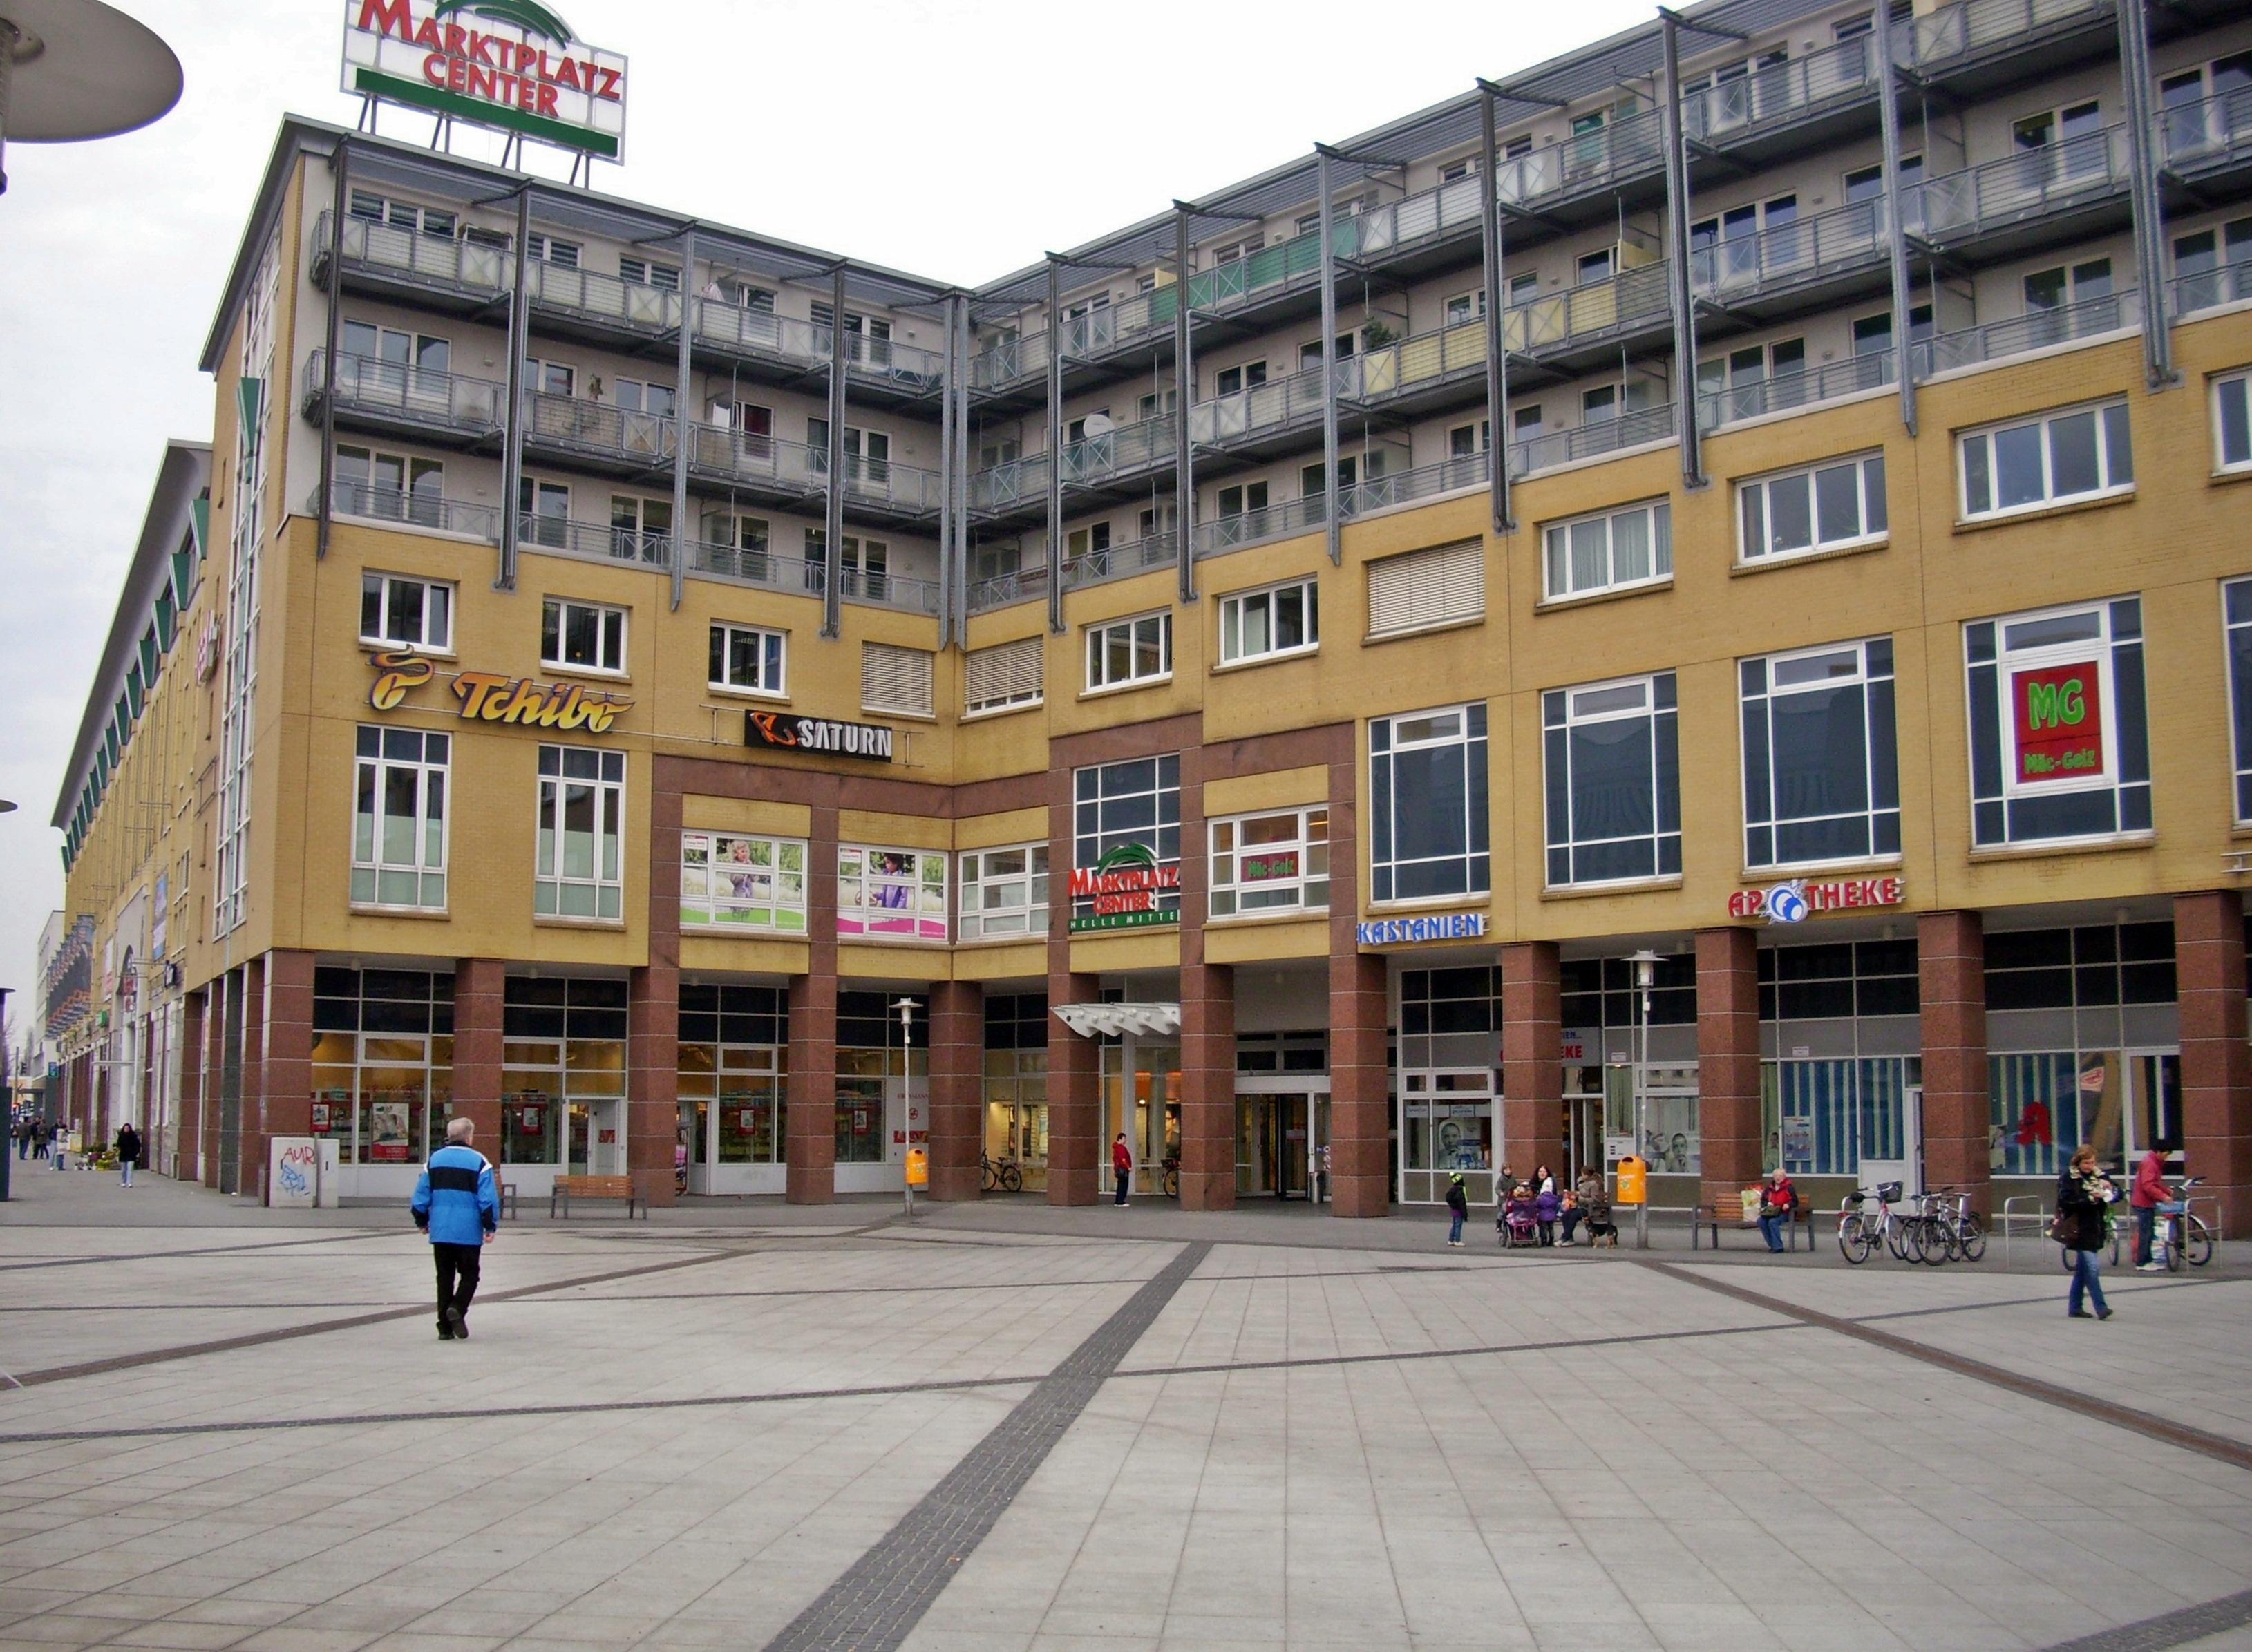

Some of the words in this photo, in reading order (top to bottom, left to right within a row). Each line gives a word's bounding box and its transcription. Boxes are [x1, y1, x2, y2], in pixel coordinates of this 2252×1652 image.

[357, 0, 621, 99] MARKTPLATZ
[423, 53, 559, 117] CENTER
[451, 671, 636, 733] Tchibo
[2028, 678, 2085, 730] MG
[797, 719, 892, 757] SATURN
[1068, 866, 1180, 897] MARKTPLATZ
[1070, 917, 1116, 929] HELLE
[1126, 911, 1175, 924] MITTE
[1093, 891, 1151, 915] CENTER
[1357, 913, 1483, 946] KASTANIEN
